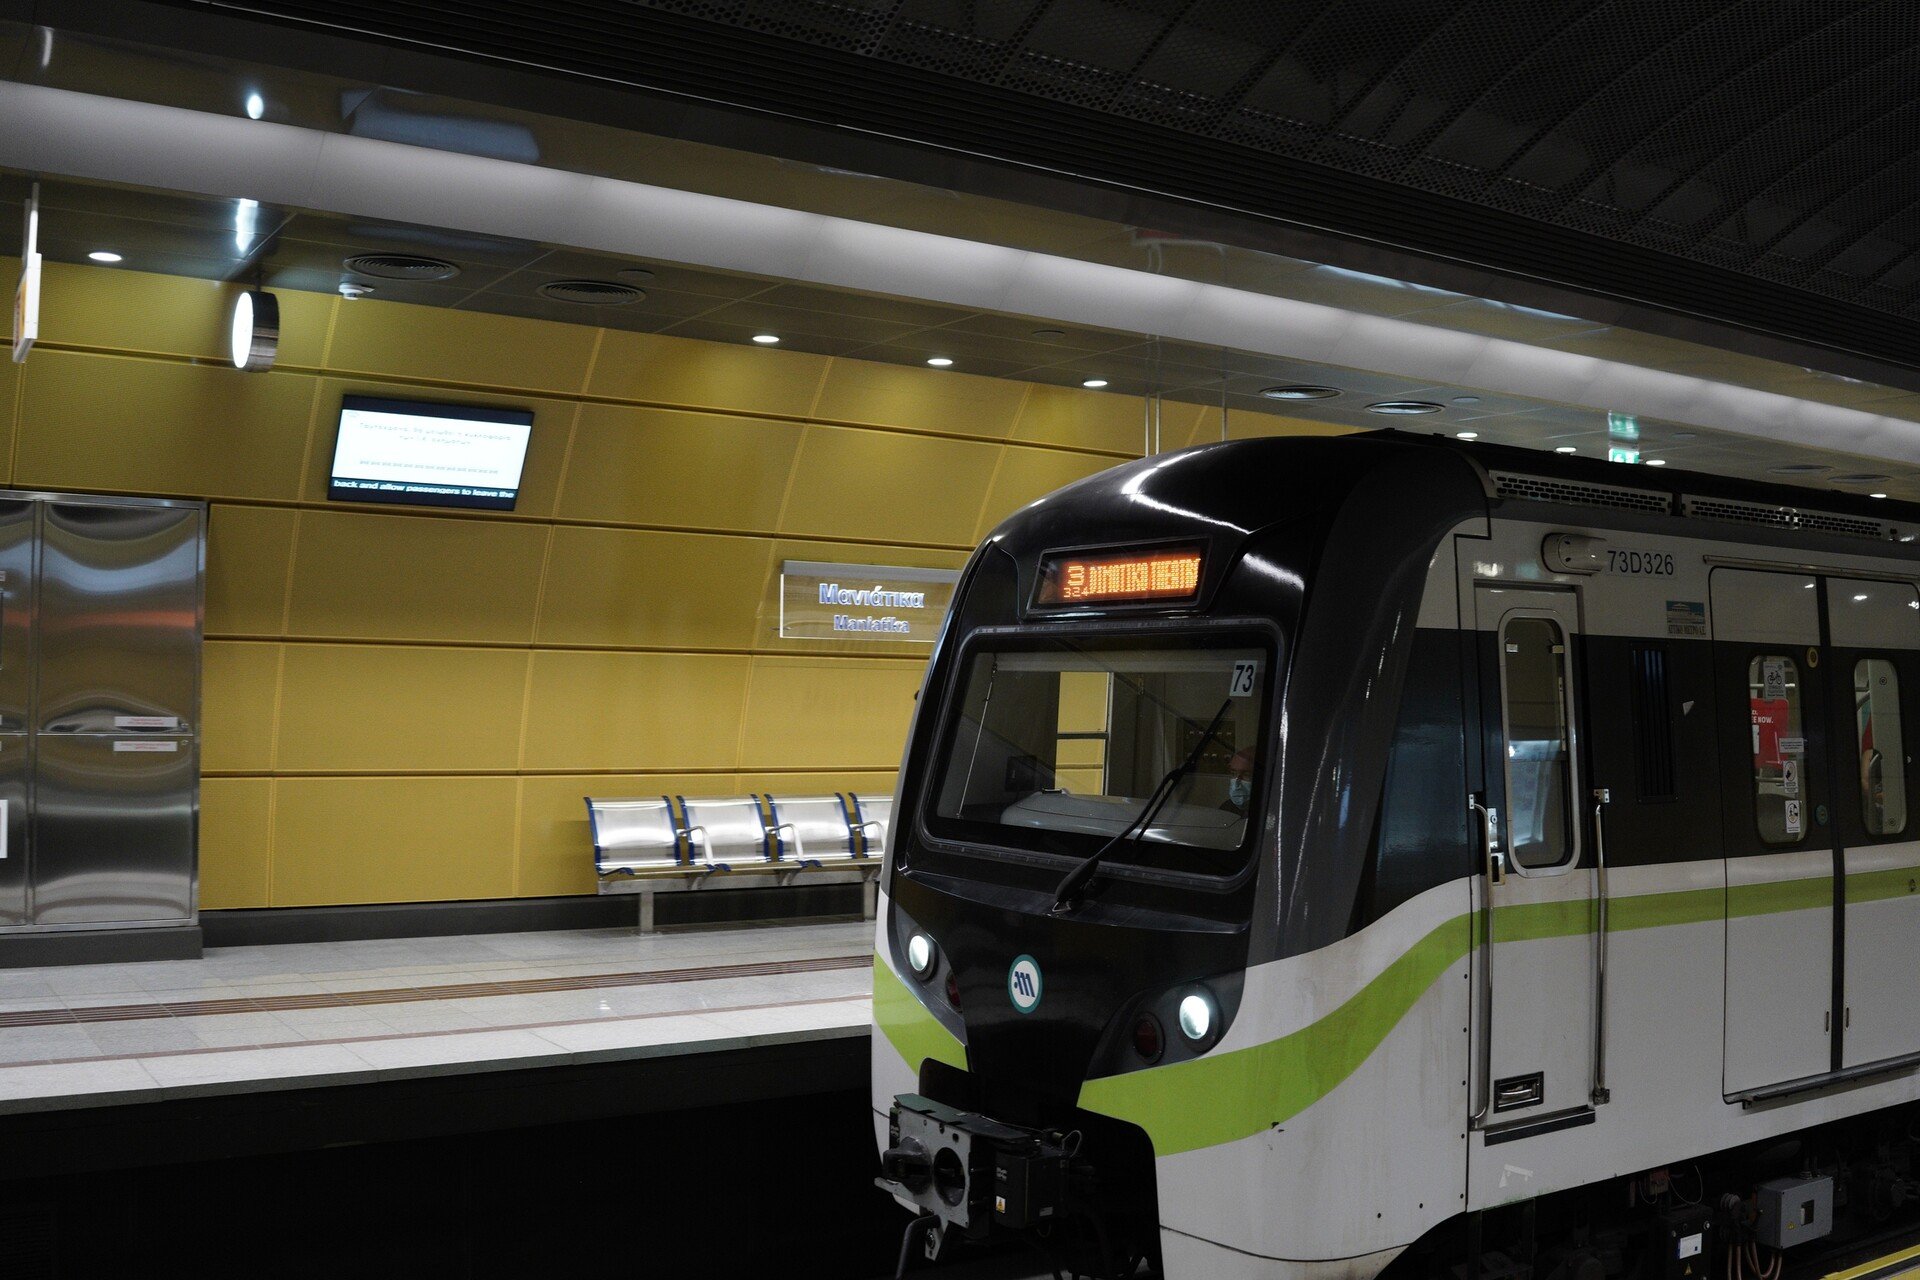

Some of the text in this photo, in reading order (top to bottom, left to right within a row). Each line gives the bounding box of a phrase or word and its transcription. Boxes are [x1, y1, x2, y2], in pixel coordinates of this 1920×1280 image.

[333, 479, 515, 499] back and allow passengers to leave the
[1607, 550, 1674, 575] 73D326
[1067, 565, 1085, 586] 3
[819, 583, 924, 608] Μανιάτικα
[833, 614, 910, 633] Maniatika
[1233, 664, 1254, 692] 73
